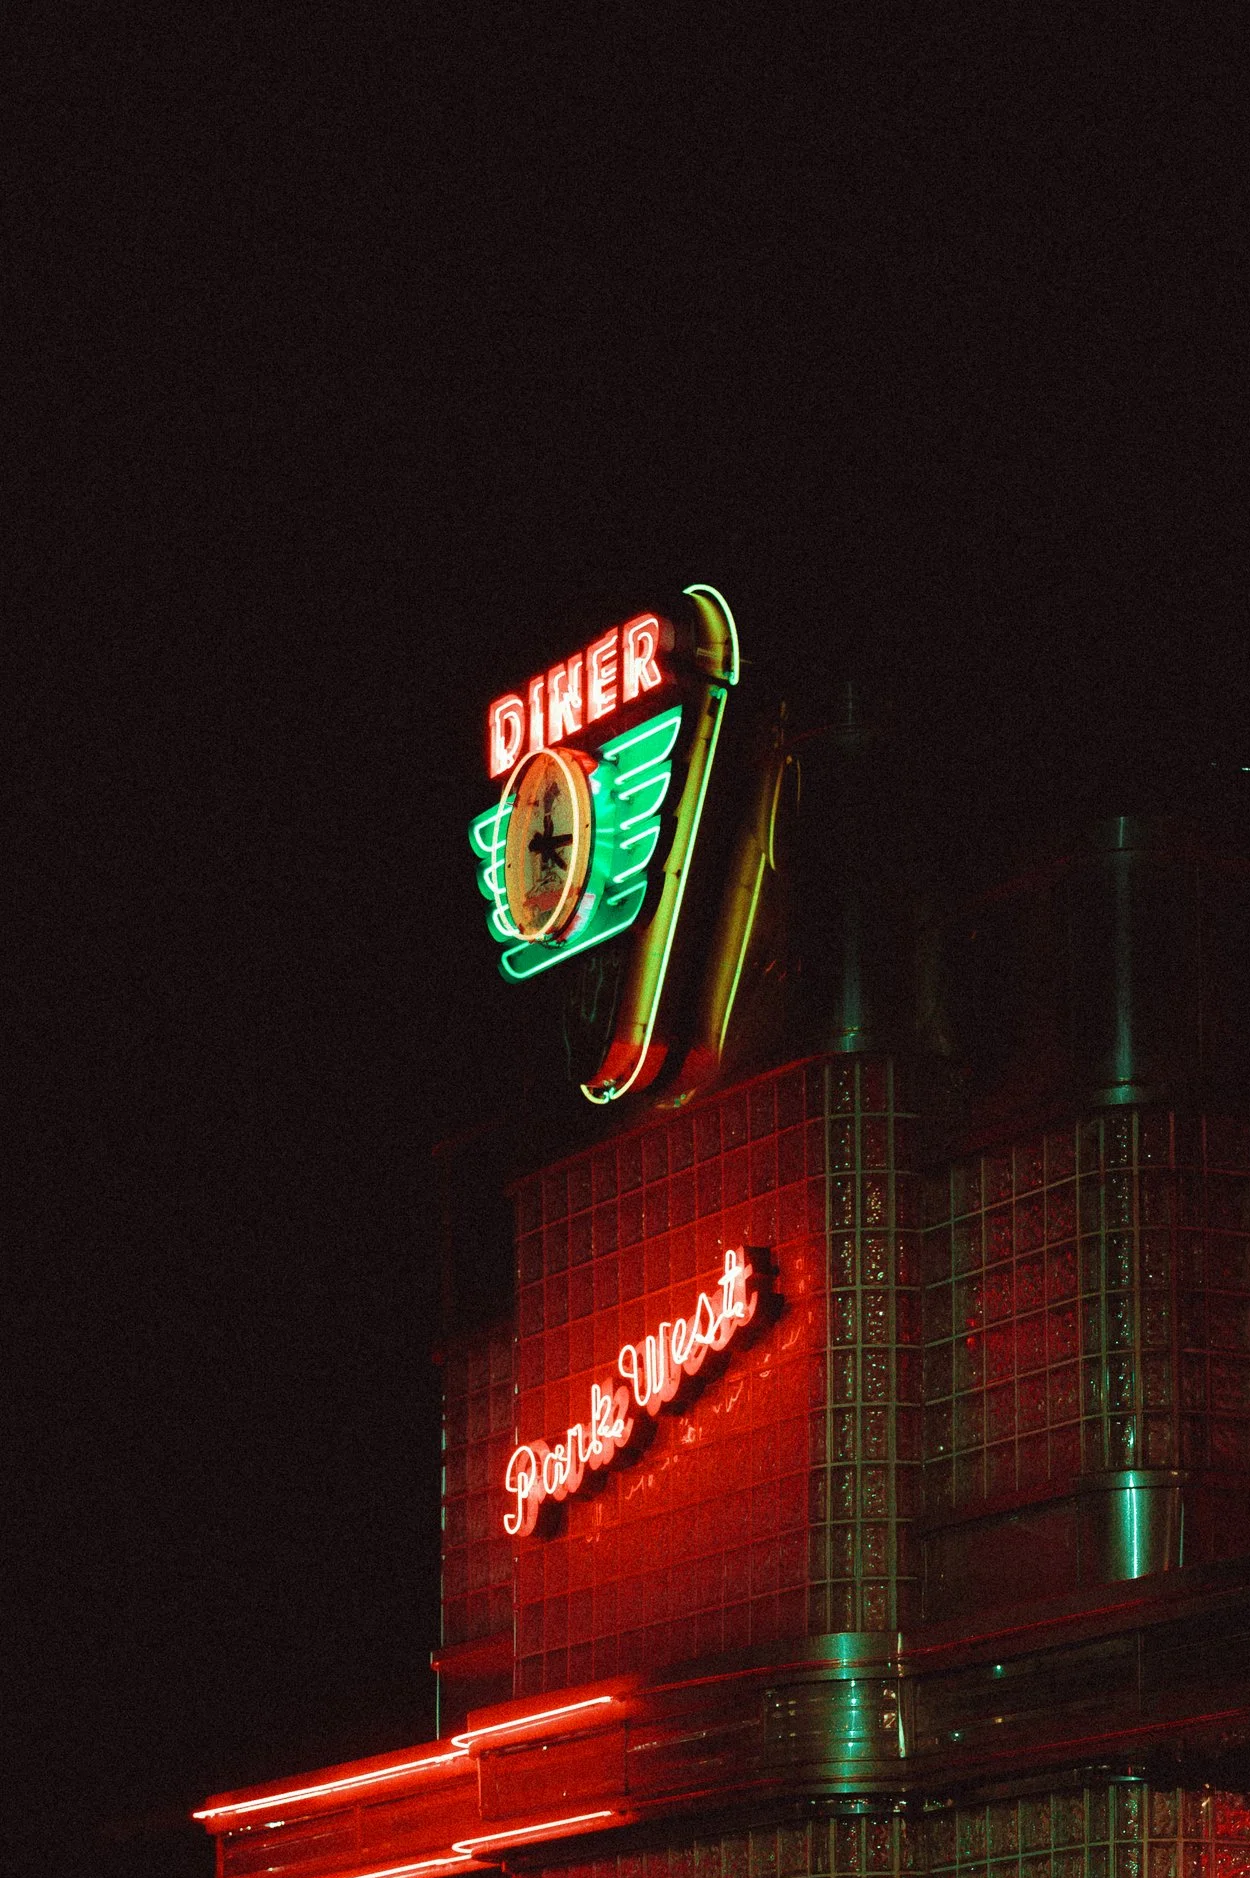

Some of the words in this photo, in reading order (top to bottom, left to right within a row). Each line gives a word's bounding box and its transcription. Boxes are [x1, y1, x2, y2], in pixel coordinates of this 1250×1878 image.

[489, 613, 662, 779] DINER
[503, 1379, 632, 1536] Park
[618, 1246, 756, 1414] West
